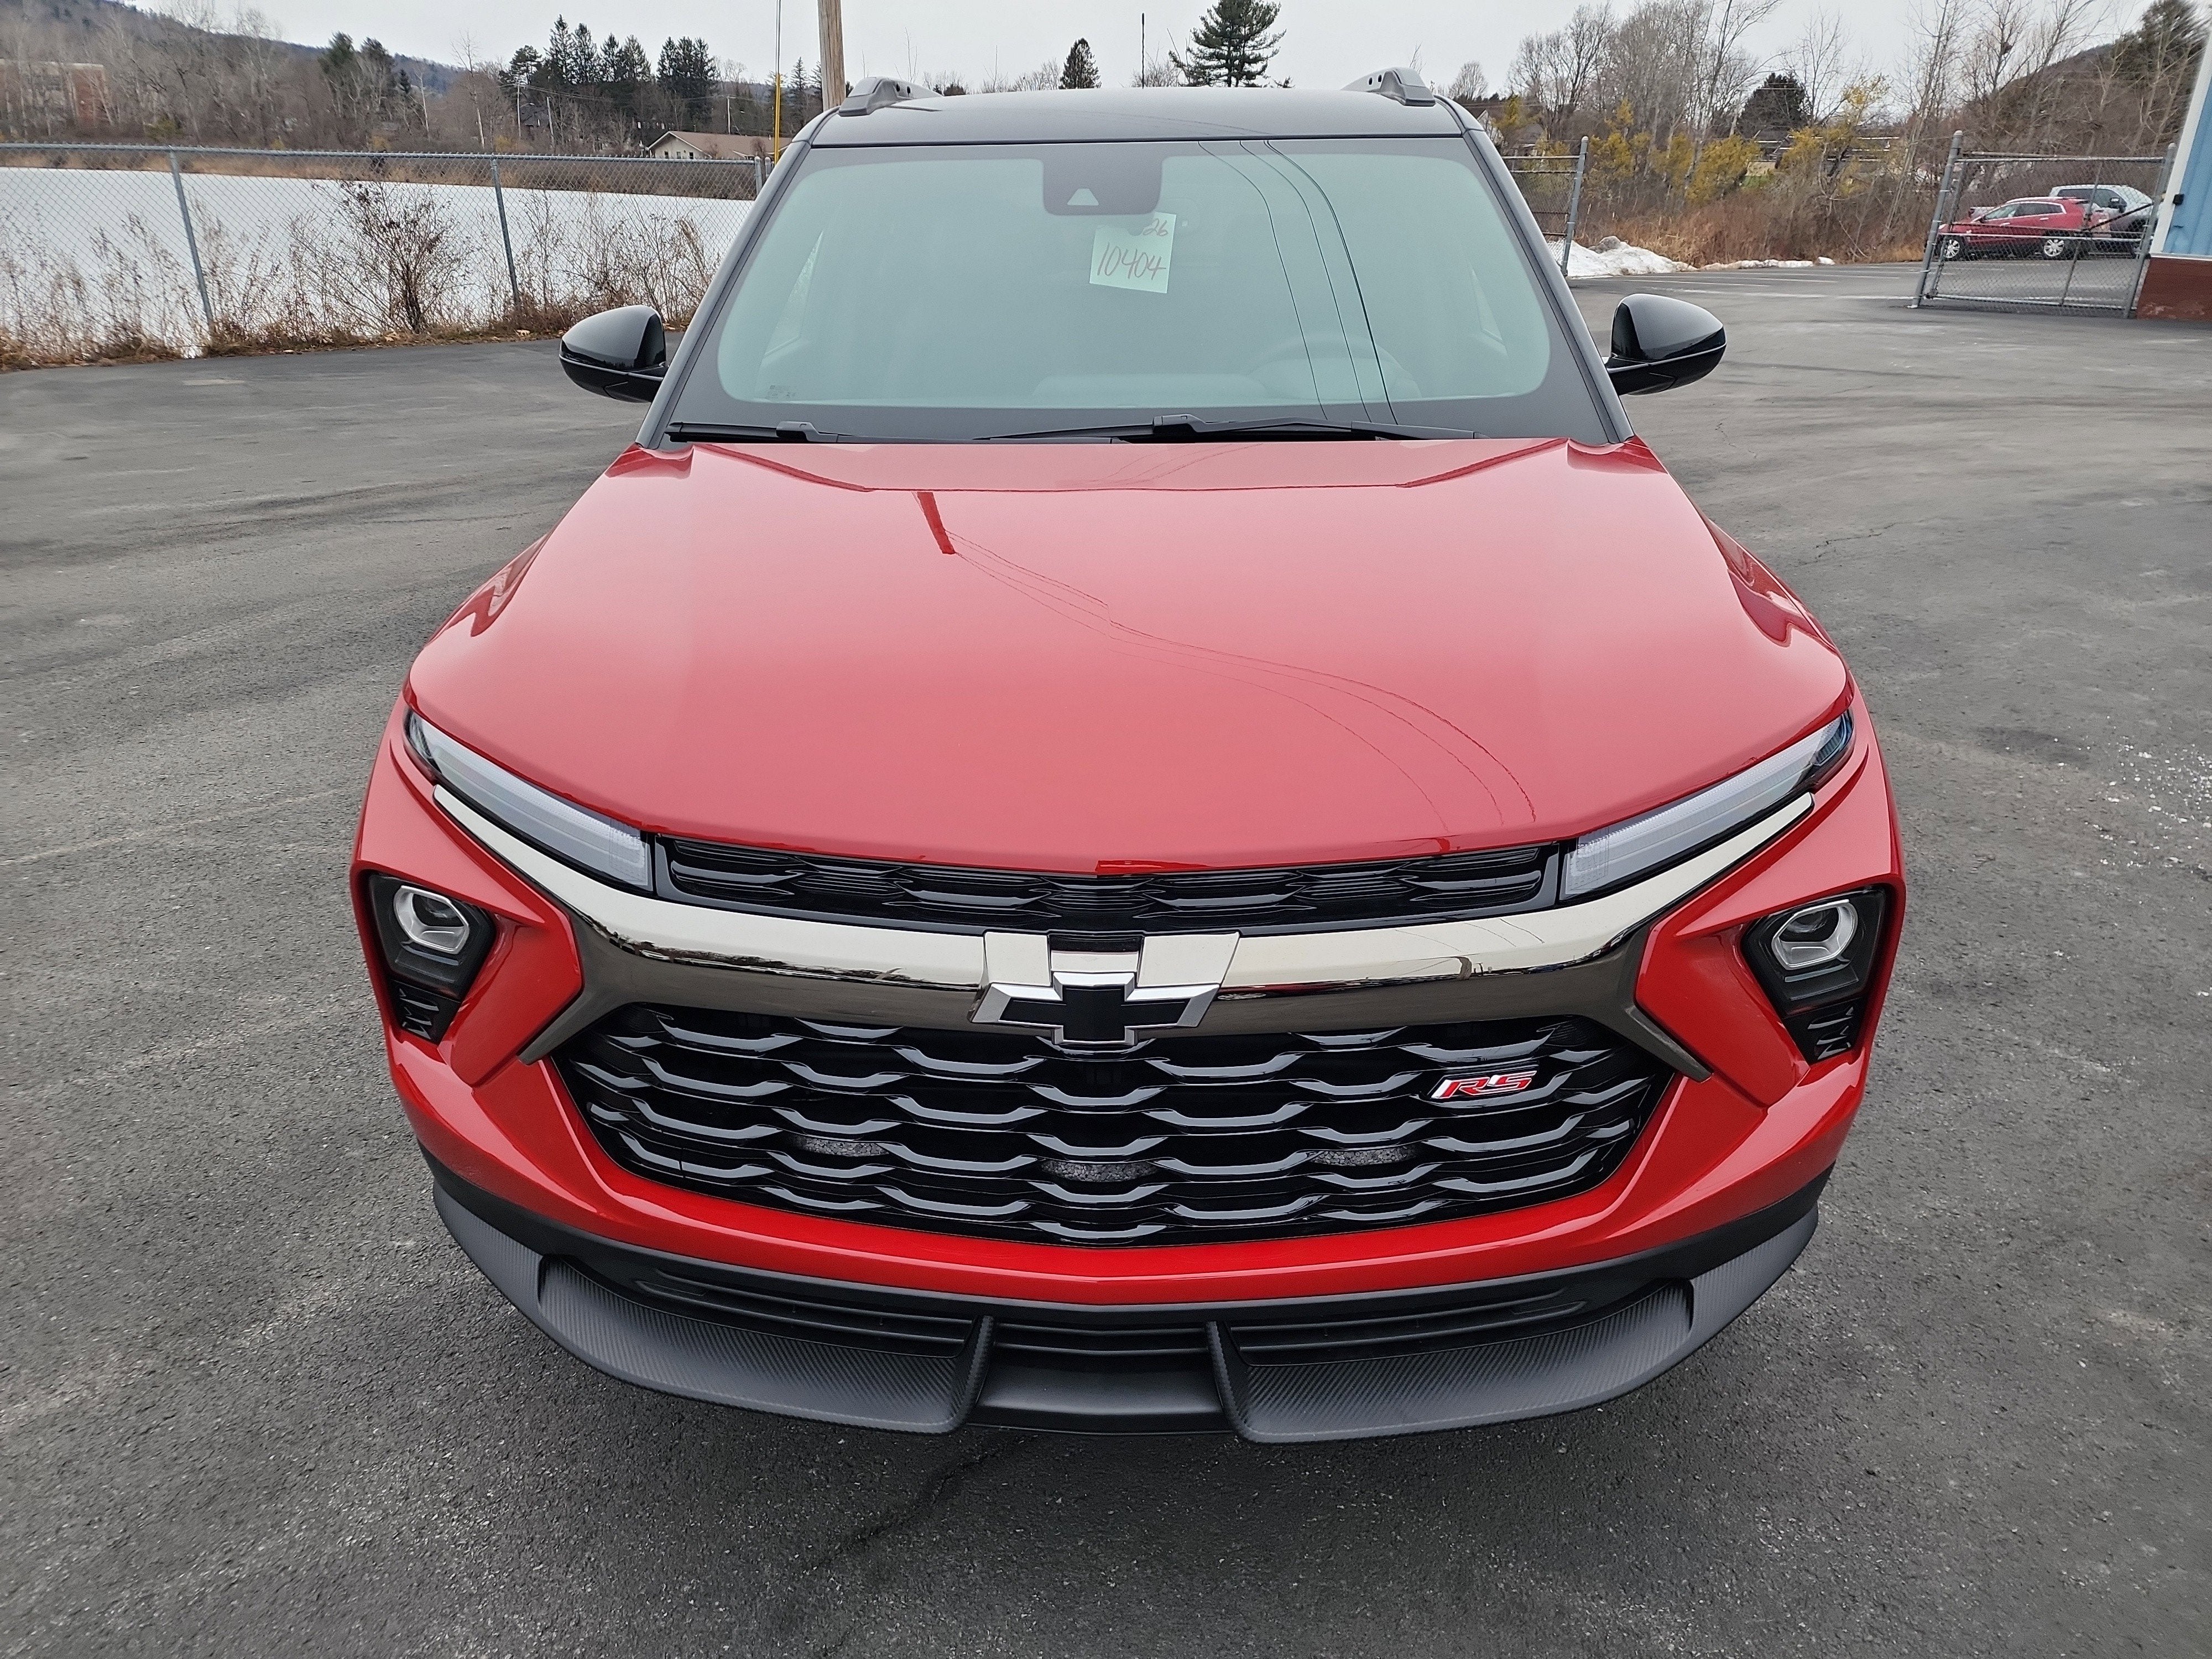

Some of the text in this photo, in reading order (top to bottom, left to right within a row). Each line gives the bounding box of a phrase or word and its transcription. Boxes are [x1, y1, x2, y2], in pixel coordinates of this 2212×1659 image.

[1142, 218, 1168, 236] 26
[1097, 242, 1166, 280] 10404
[1431, 1071, 1537, 1099] RS
